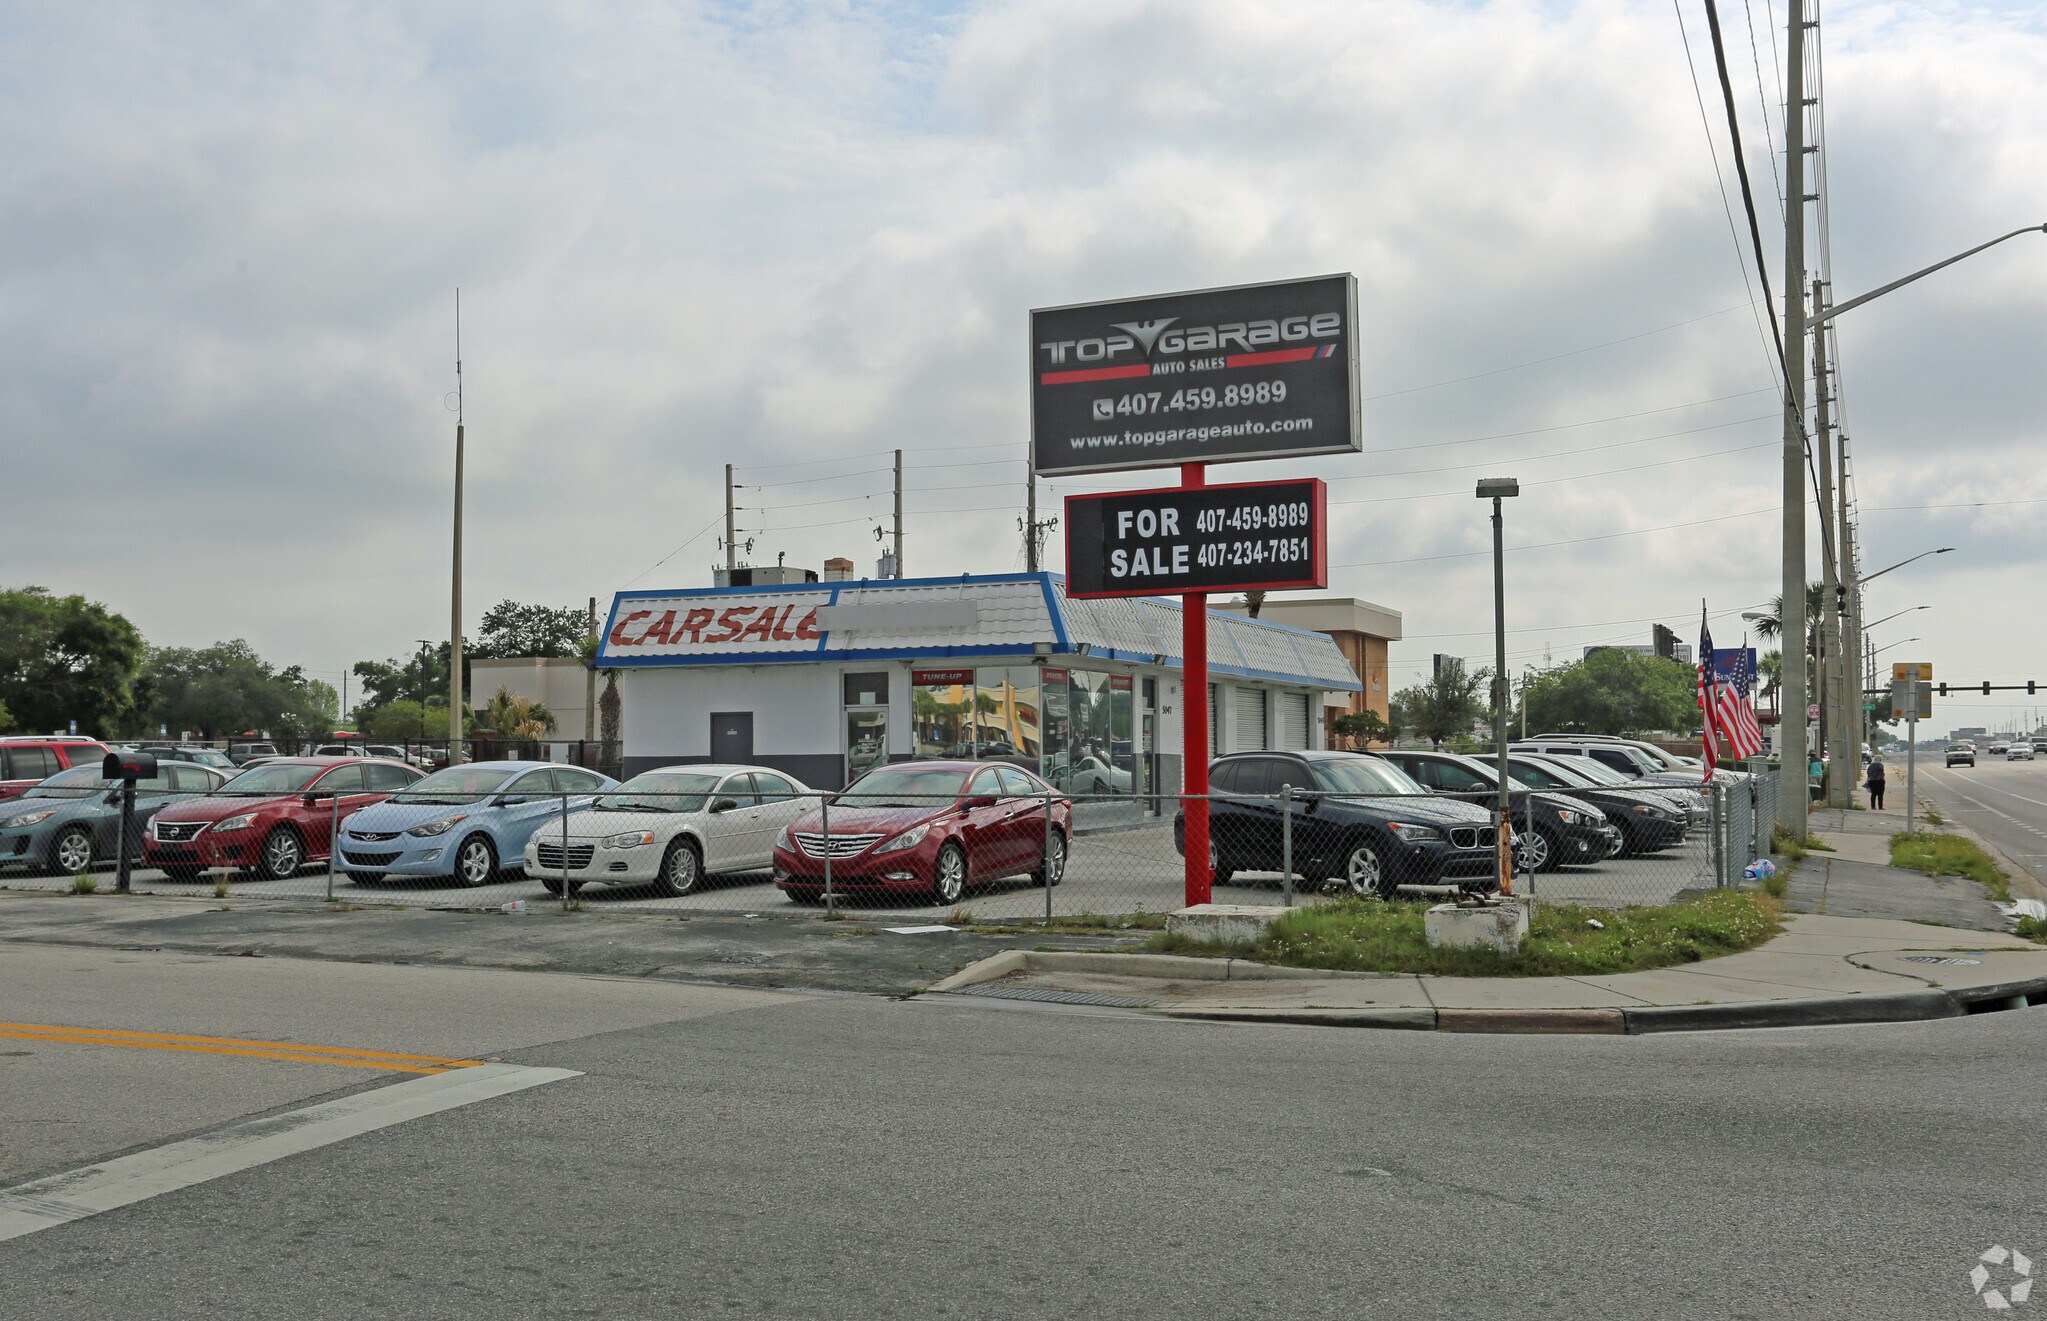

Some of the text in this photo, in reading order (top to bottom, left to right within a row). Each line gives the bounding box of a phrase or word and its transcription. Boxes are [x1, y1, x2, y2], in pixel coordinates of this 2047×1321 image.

[1040, 334, 1134, 365] TOP
[1152, 357, 1226, 376] AUTO SALES
[1116, 380, 1287, 416] 407.459.8989
[1070, 417, 1313, 449] www.topgarageauto.com
[1117, 508, 1180, 539] FOR
[1196, 502, 1309, 533] 407-459-8989
[1111, 545, 1190, 578] SALE
[1197, 537, 1308, 567] 407-234-7851
[922, 672, 963, 680] TUNE-UP
[1162, 705, 1172, 715] 5047
